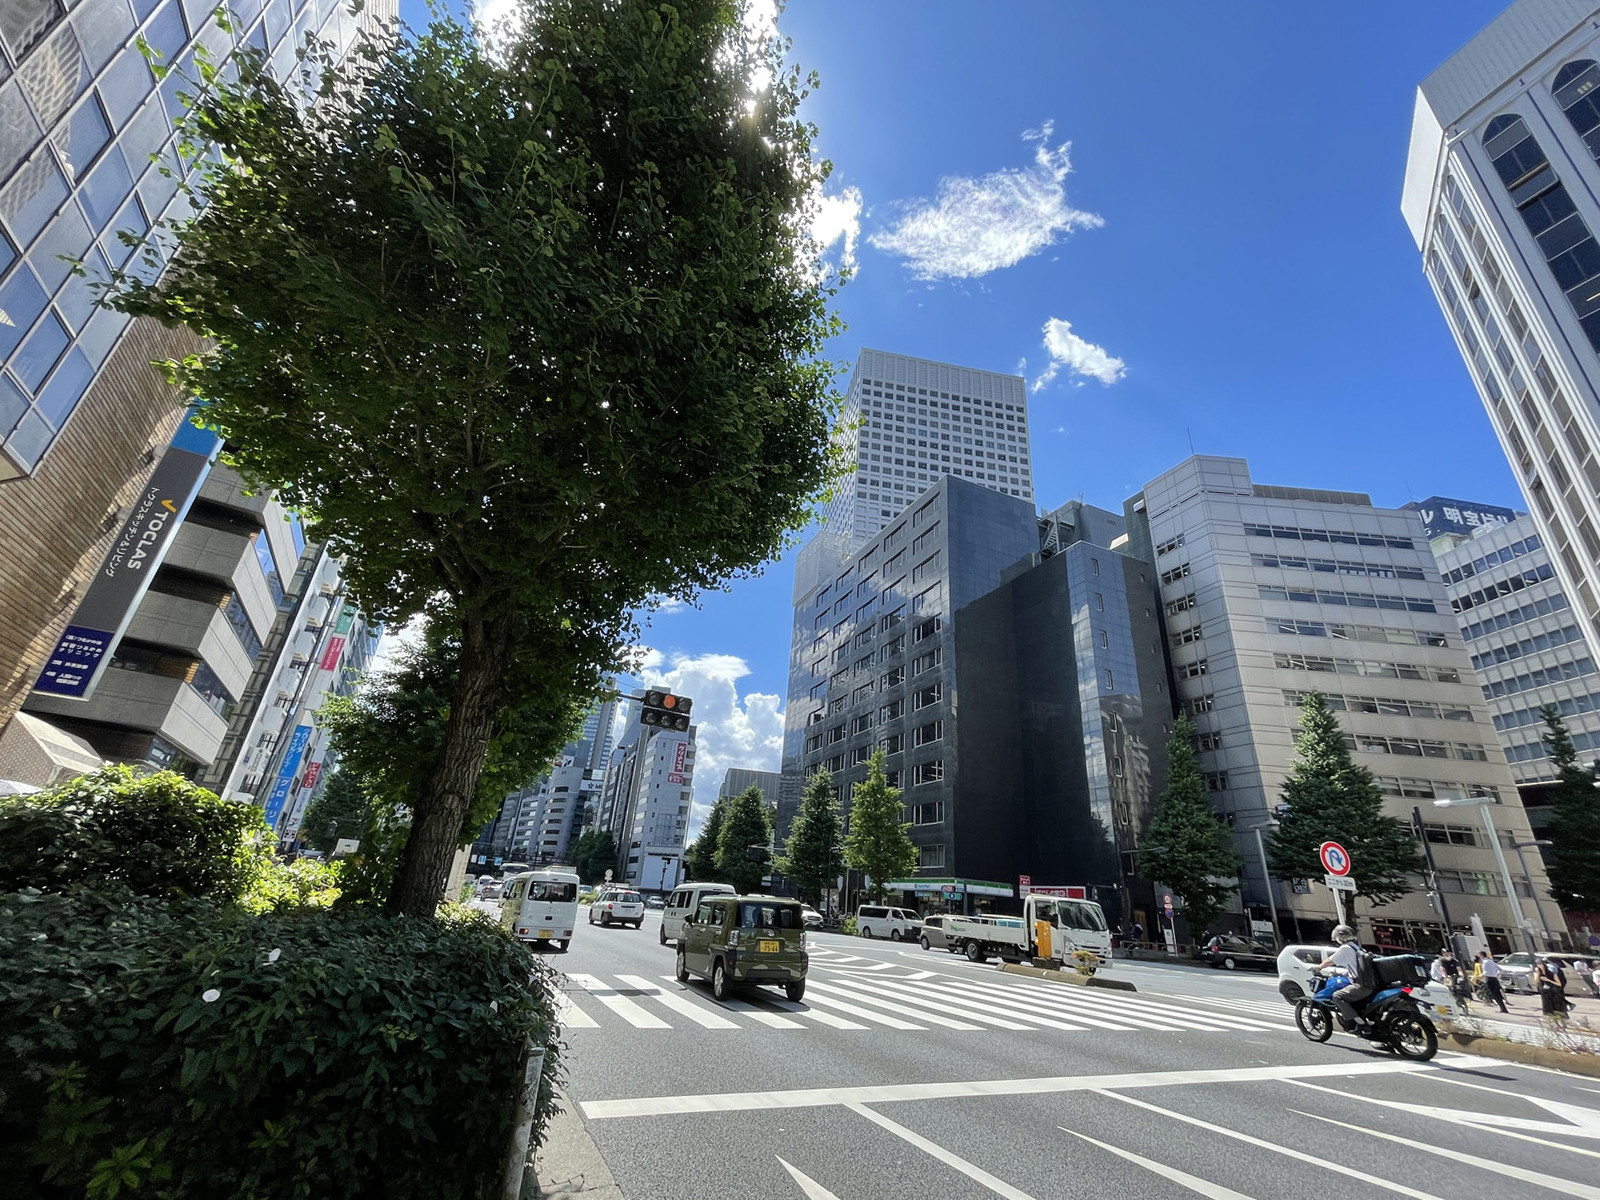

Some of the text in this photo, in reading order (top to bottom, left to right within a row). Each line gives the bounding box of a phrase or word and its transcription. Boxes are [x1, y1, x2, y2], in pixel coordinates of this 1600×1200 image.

[106, 487, 160, 577] トクラスキッチン&リビング
[127, 511, 169, 569] TOCLAS
